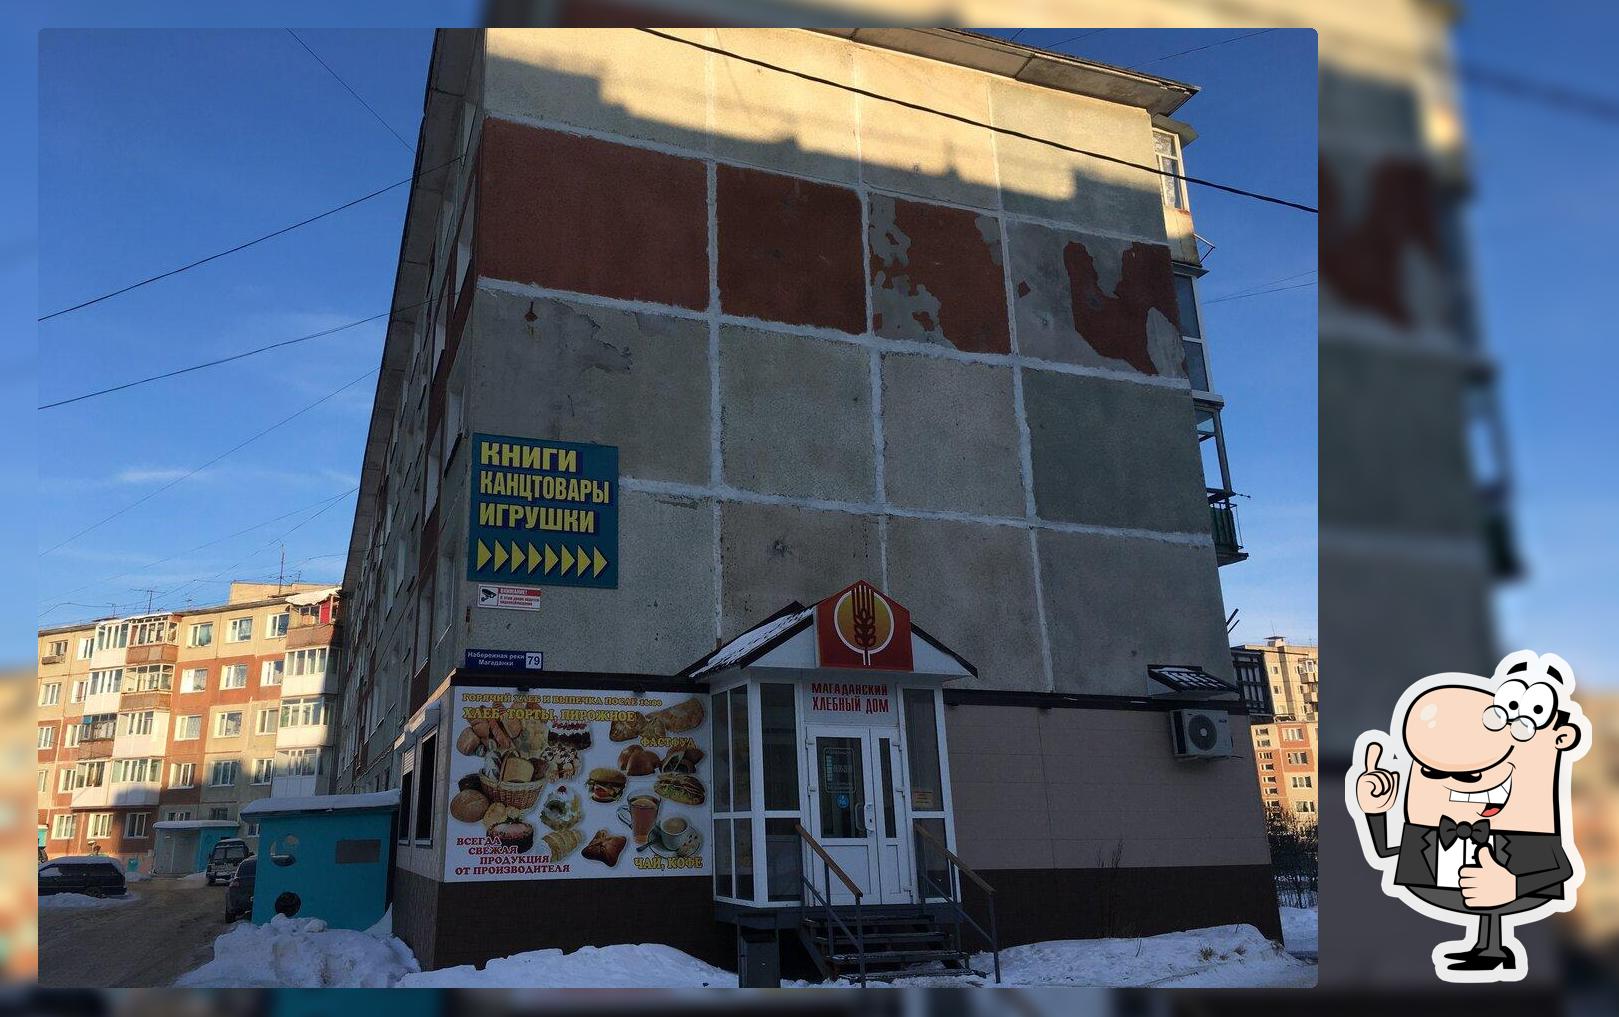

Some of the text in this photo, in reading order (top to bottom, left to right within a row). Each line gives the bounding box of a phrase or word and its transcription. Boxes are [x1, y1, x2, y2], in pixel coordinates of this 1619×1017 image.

[480, 441, 577, 473] КНИГИ
[480, 470, 610, 504] КАНЦТОВАРЫ
[479, 502, 595, 533] ИГРУШКИ
[467, 652, 508, 660] Набережная
[527, 656, 541, 666] 79
[479, 659, 514, 667] Магаданки
[812, 683, 888, 696] МАГАДАНСКИЙ
[462, 693, 511, 703] ГОРЯЧИЙ
[512, 694, 541, 703] ХЛЕБ
[542, 695, 551, 704] И
[552, 695, 603, 705] ВЫПЕЧКА
[604, 697, 637, 706] ПОСЛЕ
[813, 696, 889, 714] ХЛЕБНЫЙ ДОМ
[560, 709, 637, 722] ПИРОЖНОЕ
[640, 736, 696, 749] ФАСТФУД
[456, 836, 502, 846] ВСЕГДА
[468, 846, 518, 856] СВЕЖАЯ
[480, 855, 550, 865] ПРОДУКЦИЯ
[667, 856, 704, 869] КОФЕ
[455, 864, 570, 875] ОТ ПРОИЗВОДИТЕЛЯ
